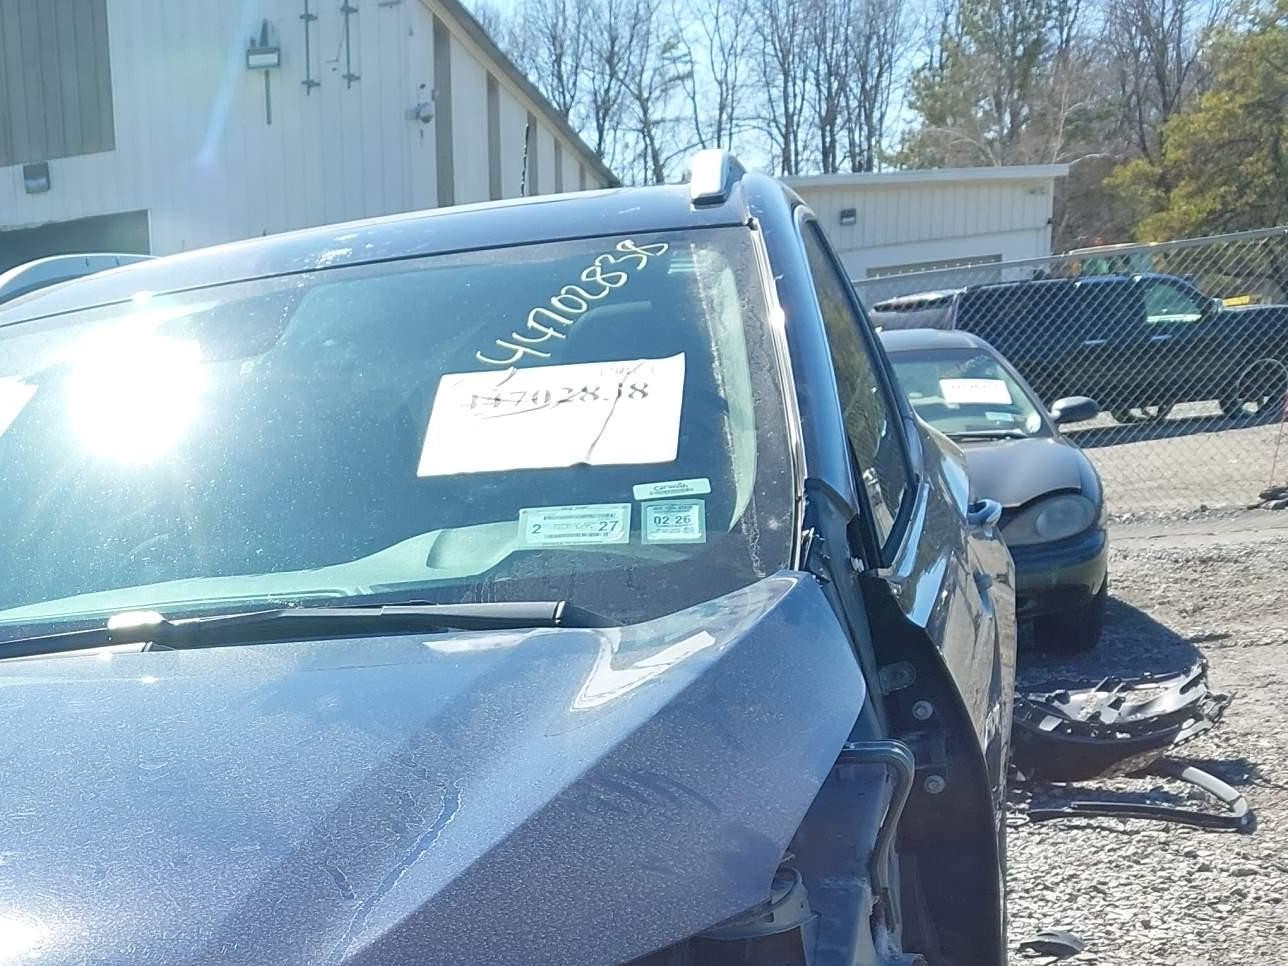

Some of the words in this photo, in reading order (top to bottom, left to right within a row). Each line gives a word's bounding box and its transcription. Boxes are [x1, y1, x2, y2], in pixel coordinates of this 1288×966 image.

[476, 239, 669, 364] 44702838
[530, 523, 542, 535] 2
[598, 520, 620, 532] 27
[653, 515, 670, 525] 02
